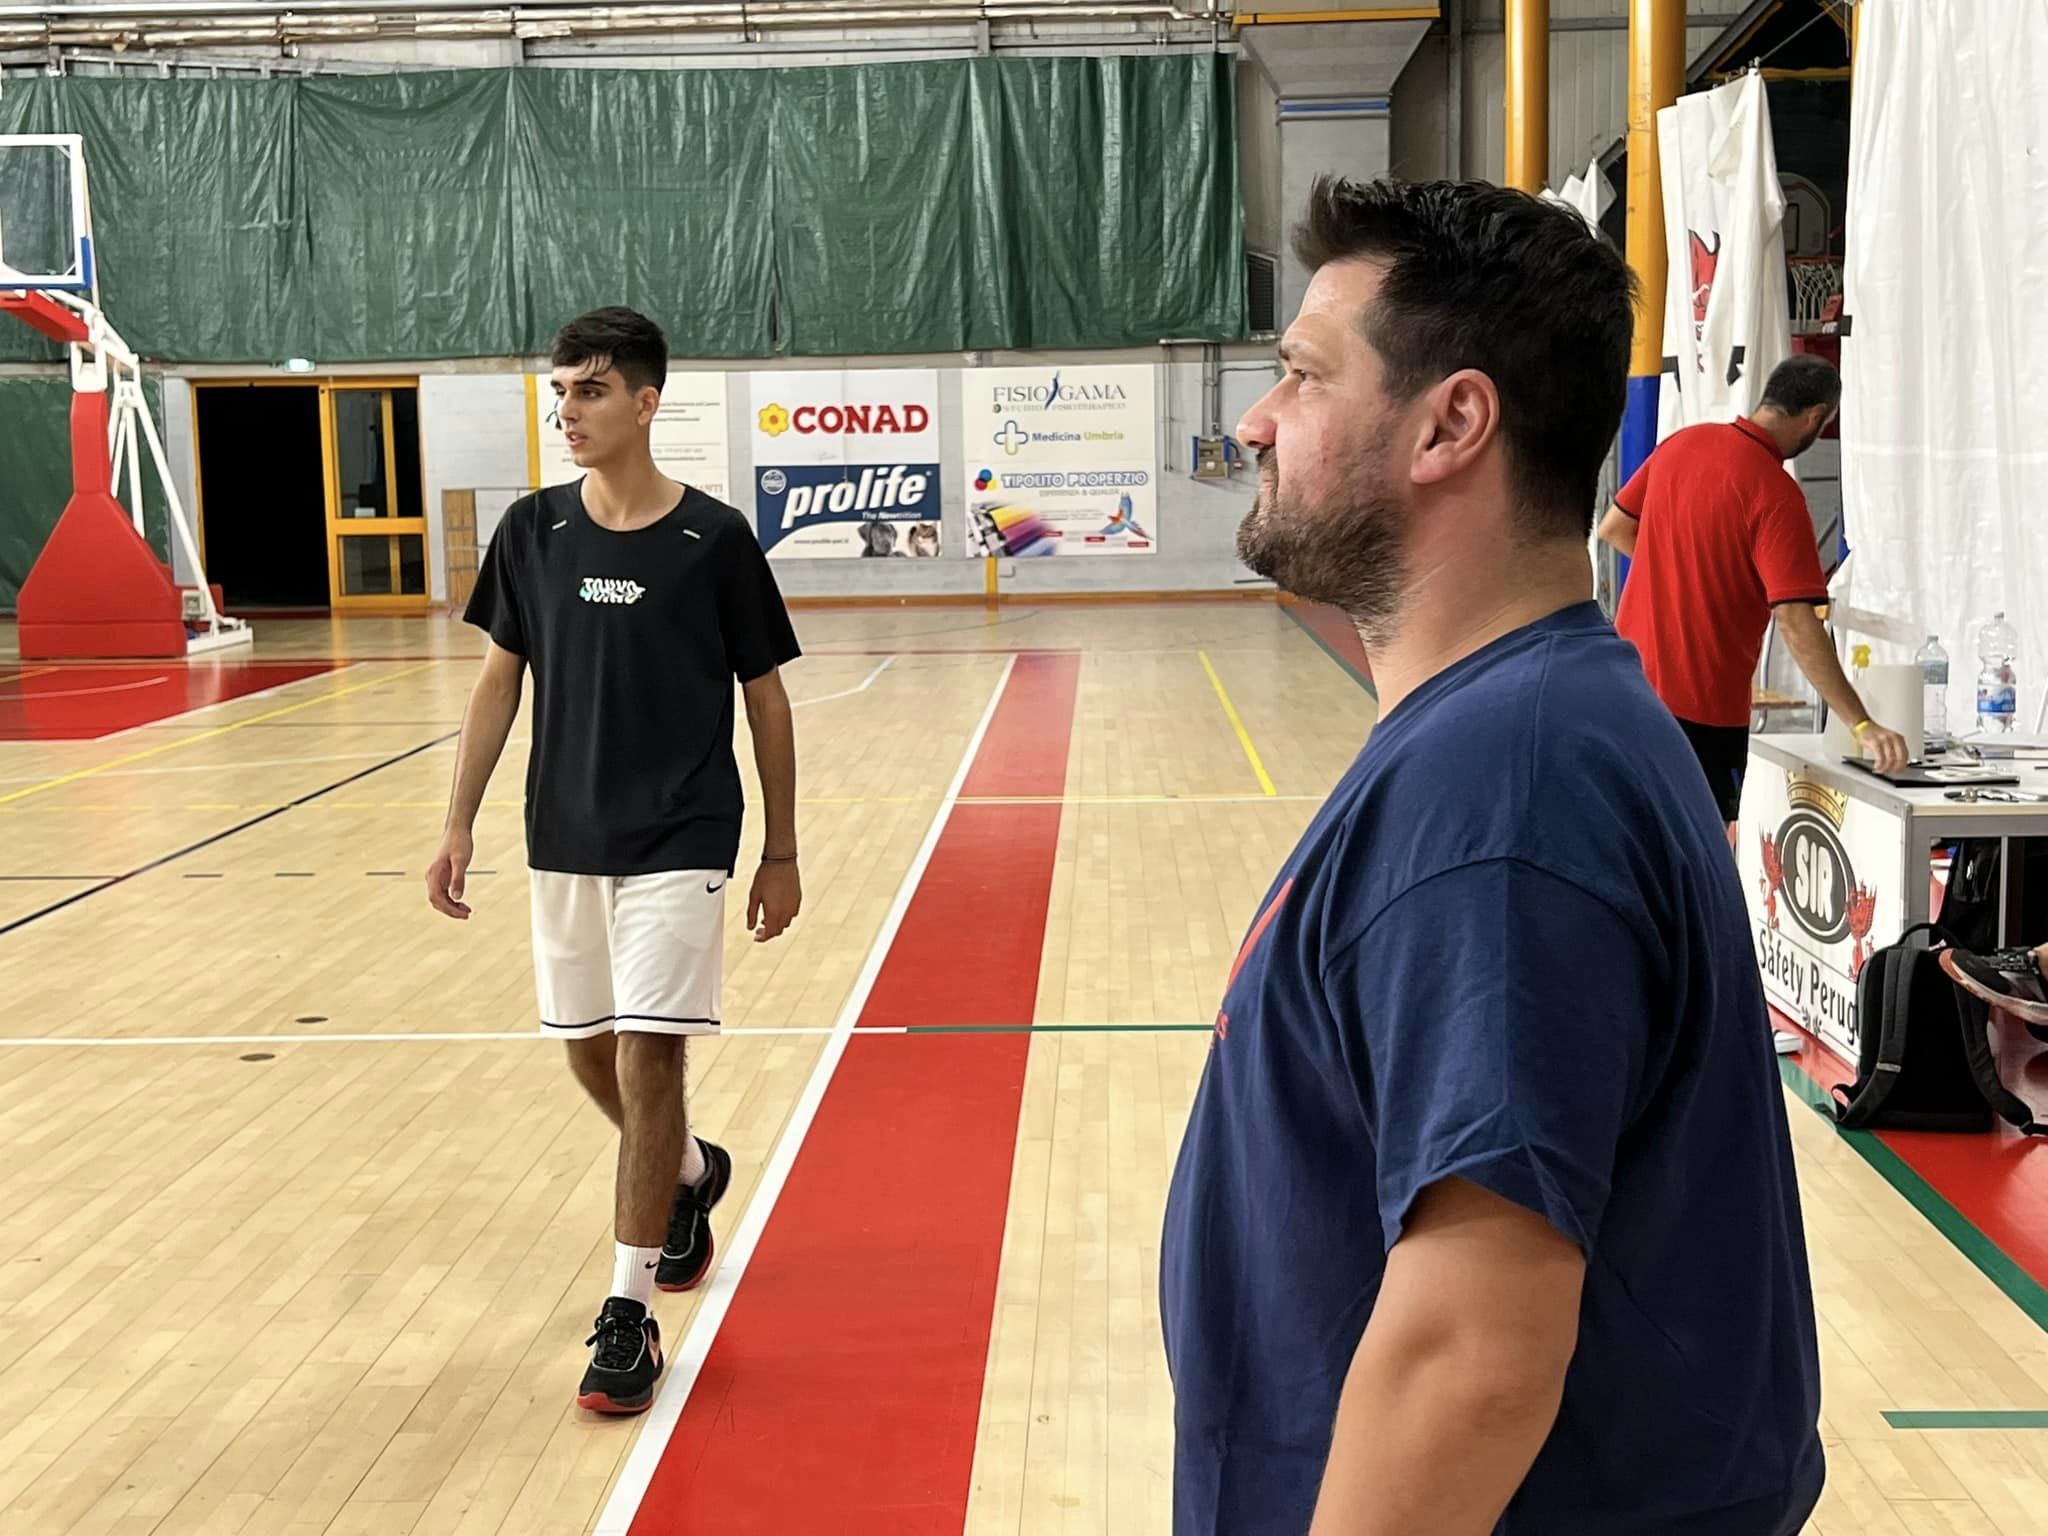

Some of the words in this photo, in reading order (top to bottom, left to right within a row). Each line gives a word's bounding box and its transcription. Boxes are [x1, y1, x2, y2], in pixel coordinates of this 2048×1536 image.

[792, 404, 929, 434] CONAD
[1032, 432, 1081, 442] Medicina
[1084, 431, 1125, 441] Umbria
[780, 465, 927, 529] prolife
[1001, 472, 1065, 488] TIPOLITO
[1067, 471, 1148, 487] PROPERZIO
[1795, 834, 1835, 924] SIR
[1758, 929, 1804, 1005] Safety
